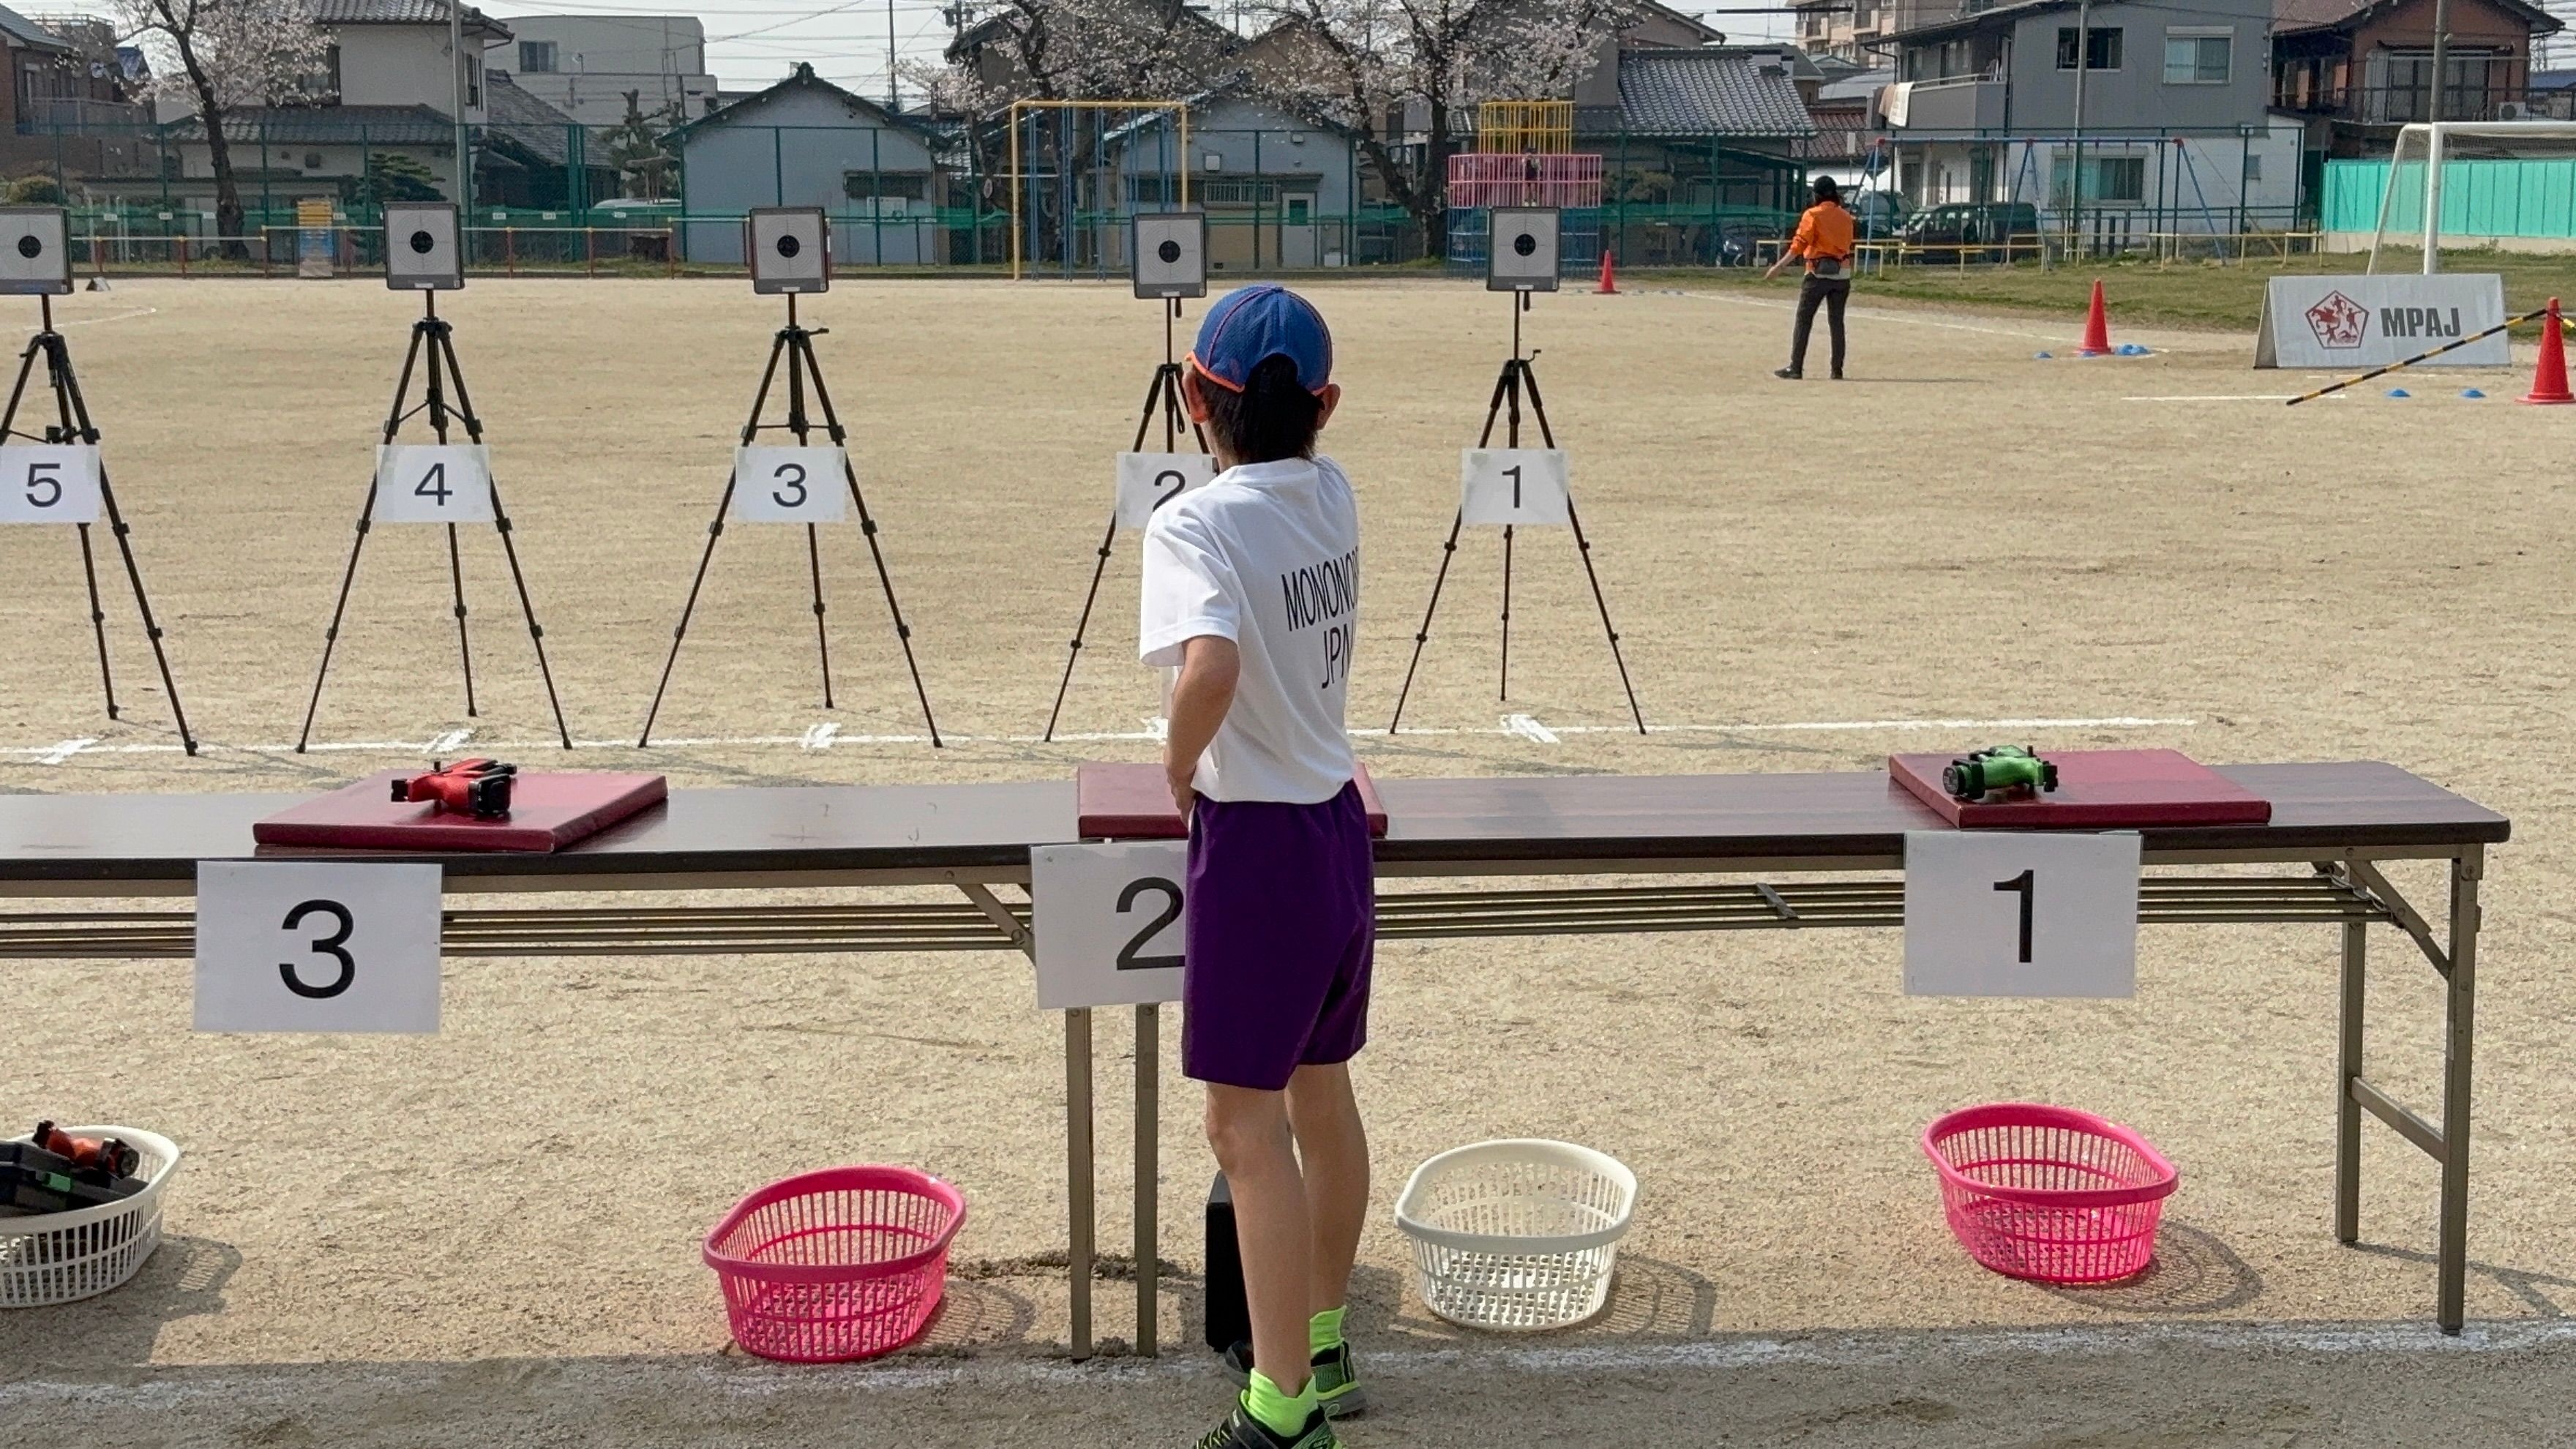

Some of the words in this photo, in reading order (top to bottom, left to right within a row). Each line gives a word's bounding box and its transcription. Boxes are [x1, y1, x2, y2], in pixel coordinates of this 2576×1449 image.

[2380, 307, 2462, 337] MPAJ
[26, 463, 62, 508] 5
[414, 463, 453, 506] 4
[772, 463, 807, 508] 3
[1152, 470, 1186, 512] 2
[1502, 465, 1521, 509] 1
[1322, 619, 1354, 689] JPN
[1116, 877, 1186, 971] 2
[1993, 869, 2034, 964] 1
[279, 899, 356, 999] 3
